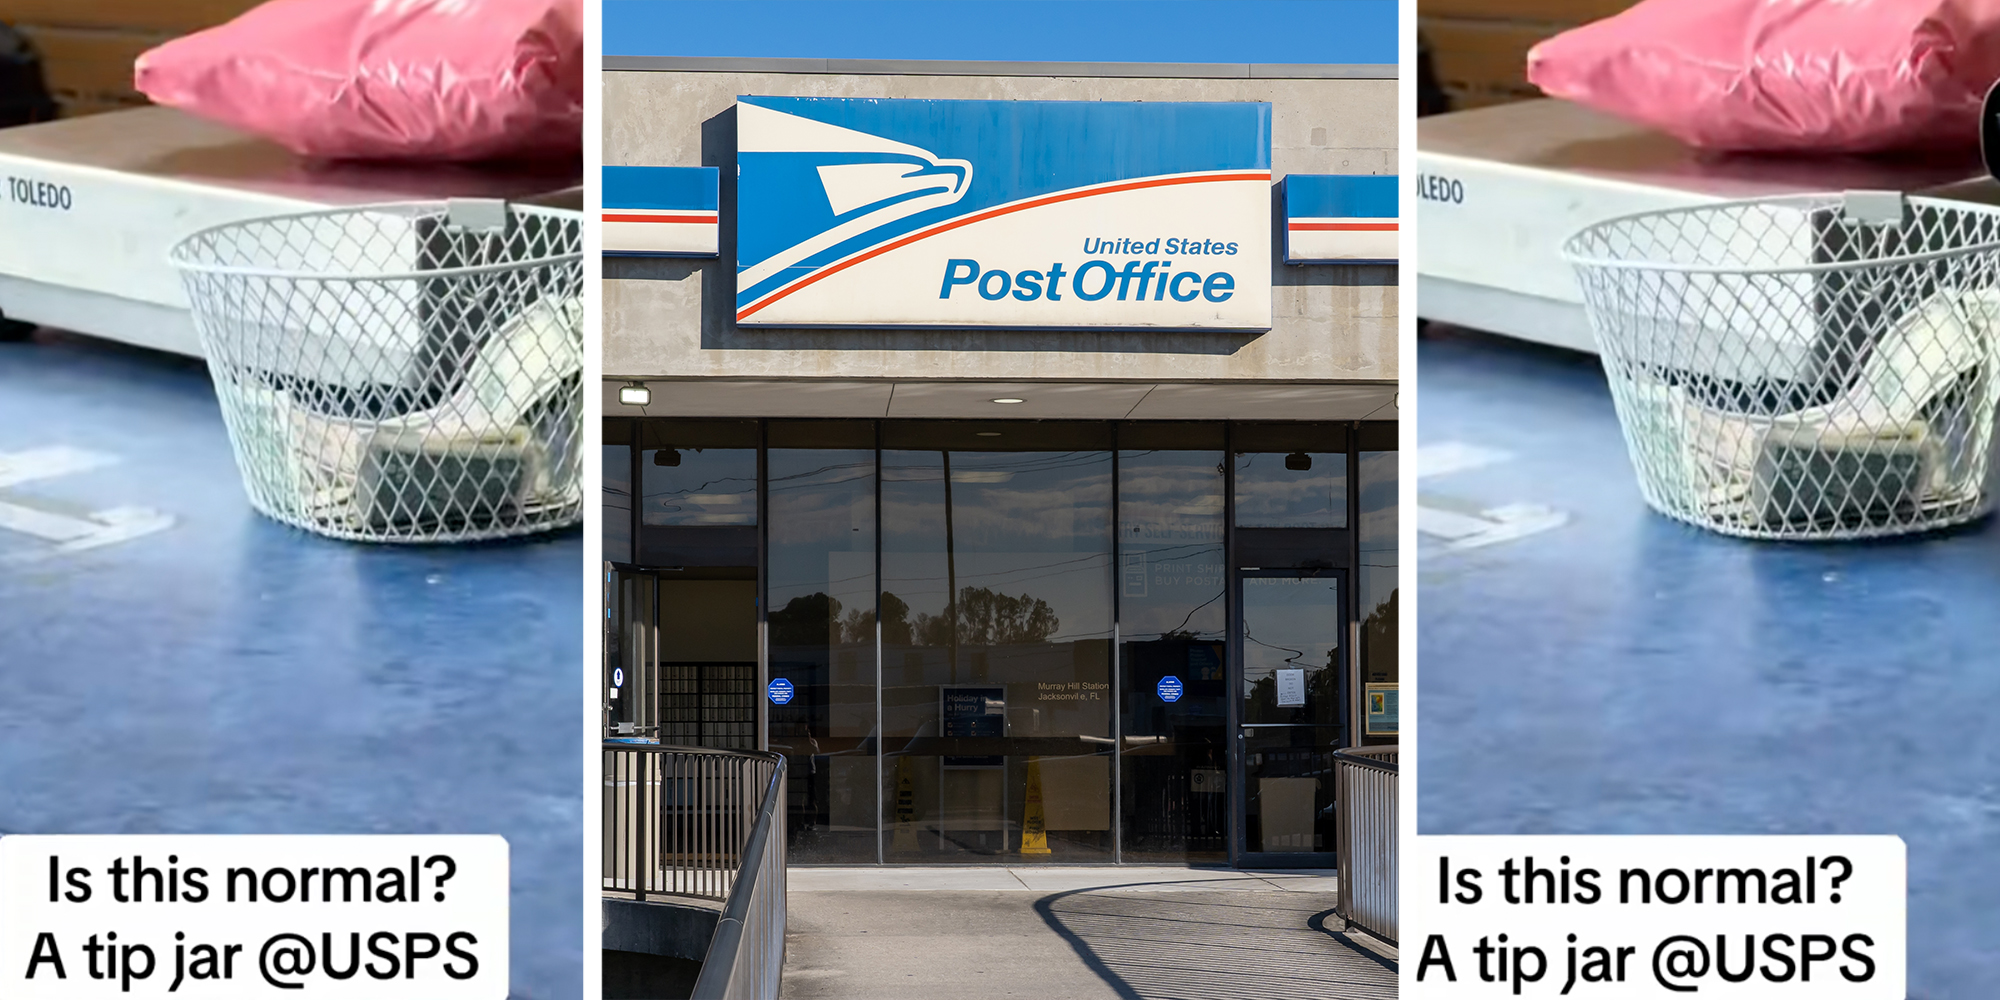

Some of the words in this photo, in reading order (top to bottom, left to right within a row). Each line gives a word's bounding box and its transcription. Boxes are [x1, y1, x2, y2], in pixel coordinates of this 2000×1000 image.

[8, 176, 71, 210] TOLEDO
[1083, 238, 1160, 255] United
[1164, 238, 1239, 255] States
[939, 259, 1066, 301] Post
[1072, 260, 1235, 303] Office
[1155, 563, 1191, 573] PRINT
[1155, 576, 1180, 586] BUY
[1249, 577, 1279, 586] AND
[1038, 682, 1065, 691] Murray
[1067, 682, 1080, 690] Hill
[1082, 682, 1109, 690] Station
[946, 694, 978, 704] Holiday
[1089, 692, 1101, 700] FL
[954, 704, 978, 713] Hurry
